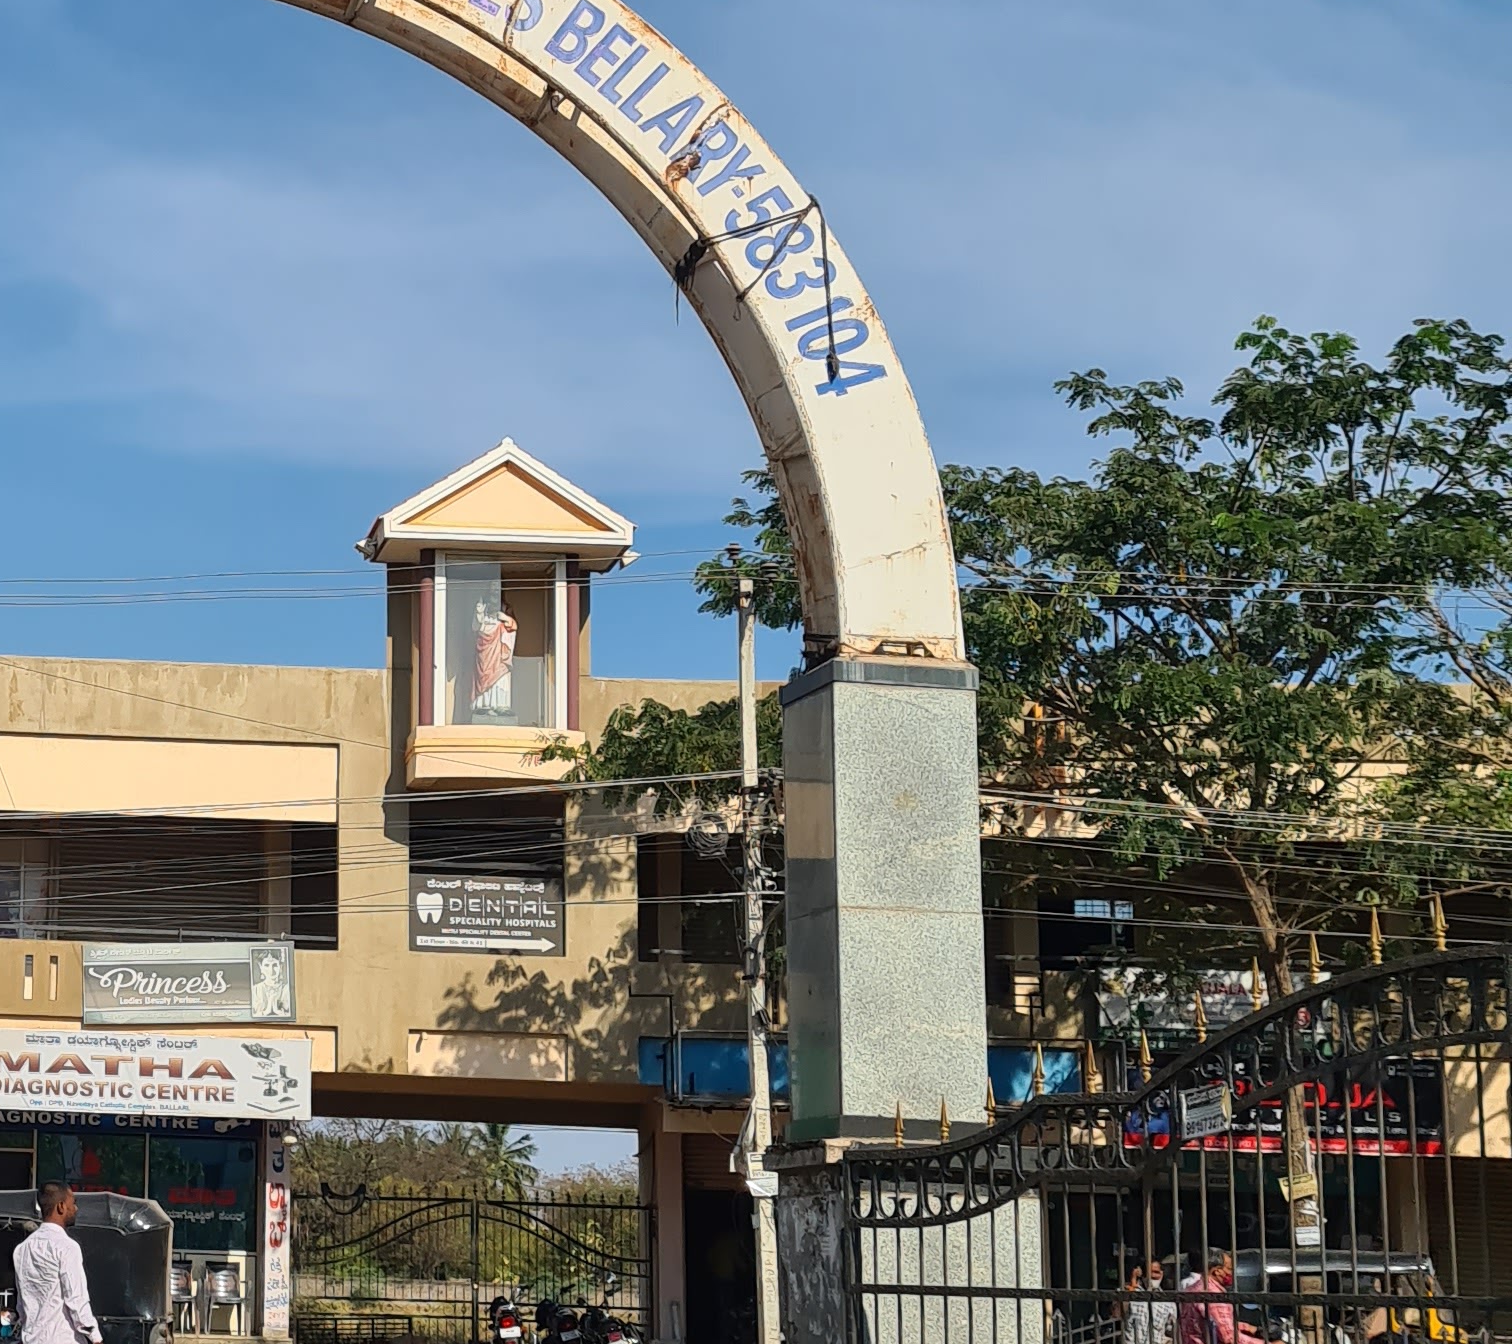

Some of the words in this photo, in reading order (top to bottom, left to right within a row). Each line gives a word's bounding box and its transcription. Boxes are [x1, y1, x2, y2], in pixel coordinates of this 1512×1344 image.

[449, 916, 502, 927] SPECIALITY
[506, 918, 557, 928] HOSPITALS
[88, 967, 232, 998] Princess
[140, 1081, 236, 1103] CENTRE
[113, 1113, 200, 1129] CENTRE
